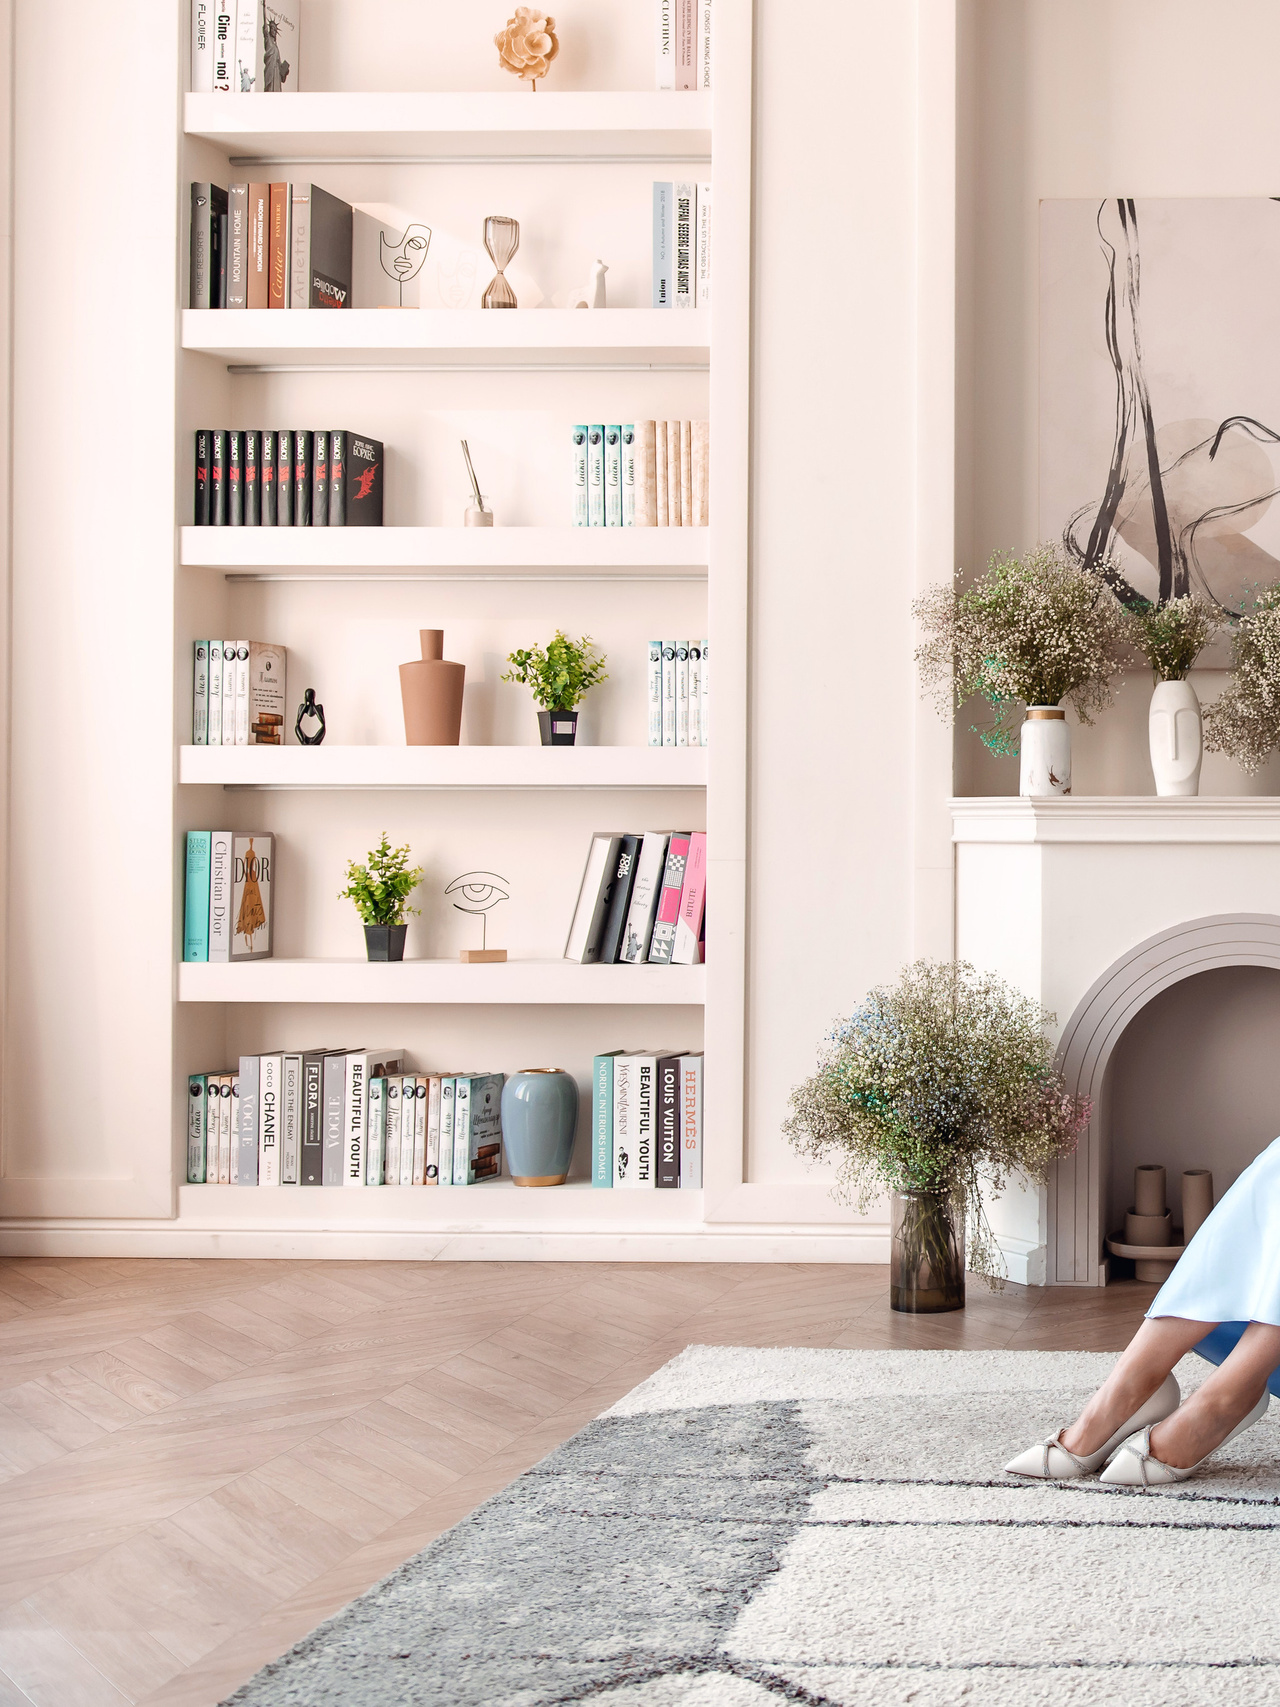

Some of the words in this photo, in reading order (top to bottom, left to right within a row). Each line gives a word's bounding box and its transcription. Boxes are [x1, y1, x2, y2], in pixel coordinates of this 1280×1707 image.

[197, 3, 206, 51] FLOWER
[217, 14, 230, 40] Cine
[216, 62, 229, 80] noi
[232, 238, 241, 282] MOUNTAIN
[272, 247, 284, 298] Cartier
[214, 841, 228, 901] Christian
[234, 857, 270, 884] DIOR
[617, 852, 627, 878] FORD
[623, 854, 632, 876] TOM
[213, 906, 226, 936] Dior
[308, 1067, 318, 1109] FLORA
[352, 1064, 362, 1132] BEAUTIFUL
[598, 1062, 607, 1097] NORDIC
[639, 1067, 650, 1134] BEAUTIFUL
[664, 1069, 674, 1104] LOUIS
[243, 1095, 254, 1147] VOGUE
[264, 1092, 275, 1152] CHANEL
[328, 1096, 340, 1149] VOGUE
[598, 1099, 606, 1146] INTERIORS
[663, 1109, 674, 1162] VUITTON
[350, 1136, 360, 1178] YOUTH
[639, 1138, 650, 1180] YOUTH
